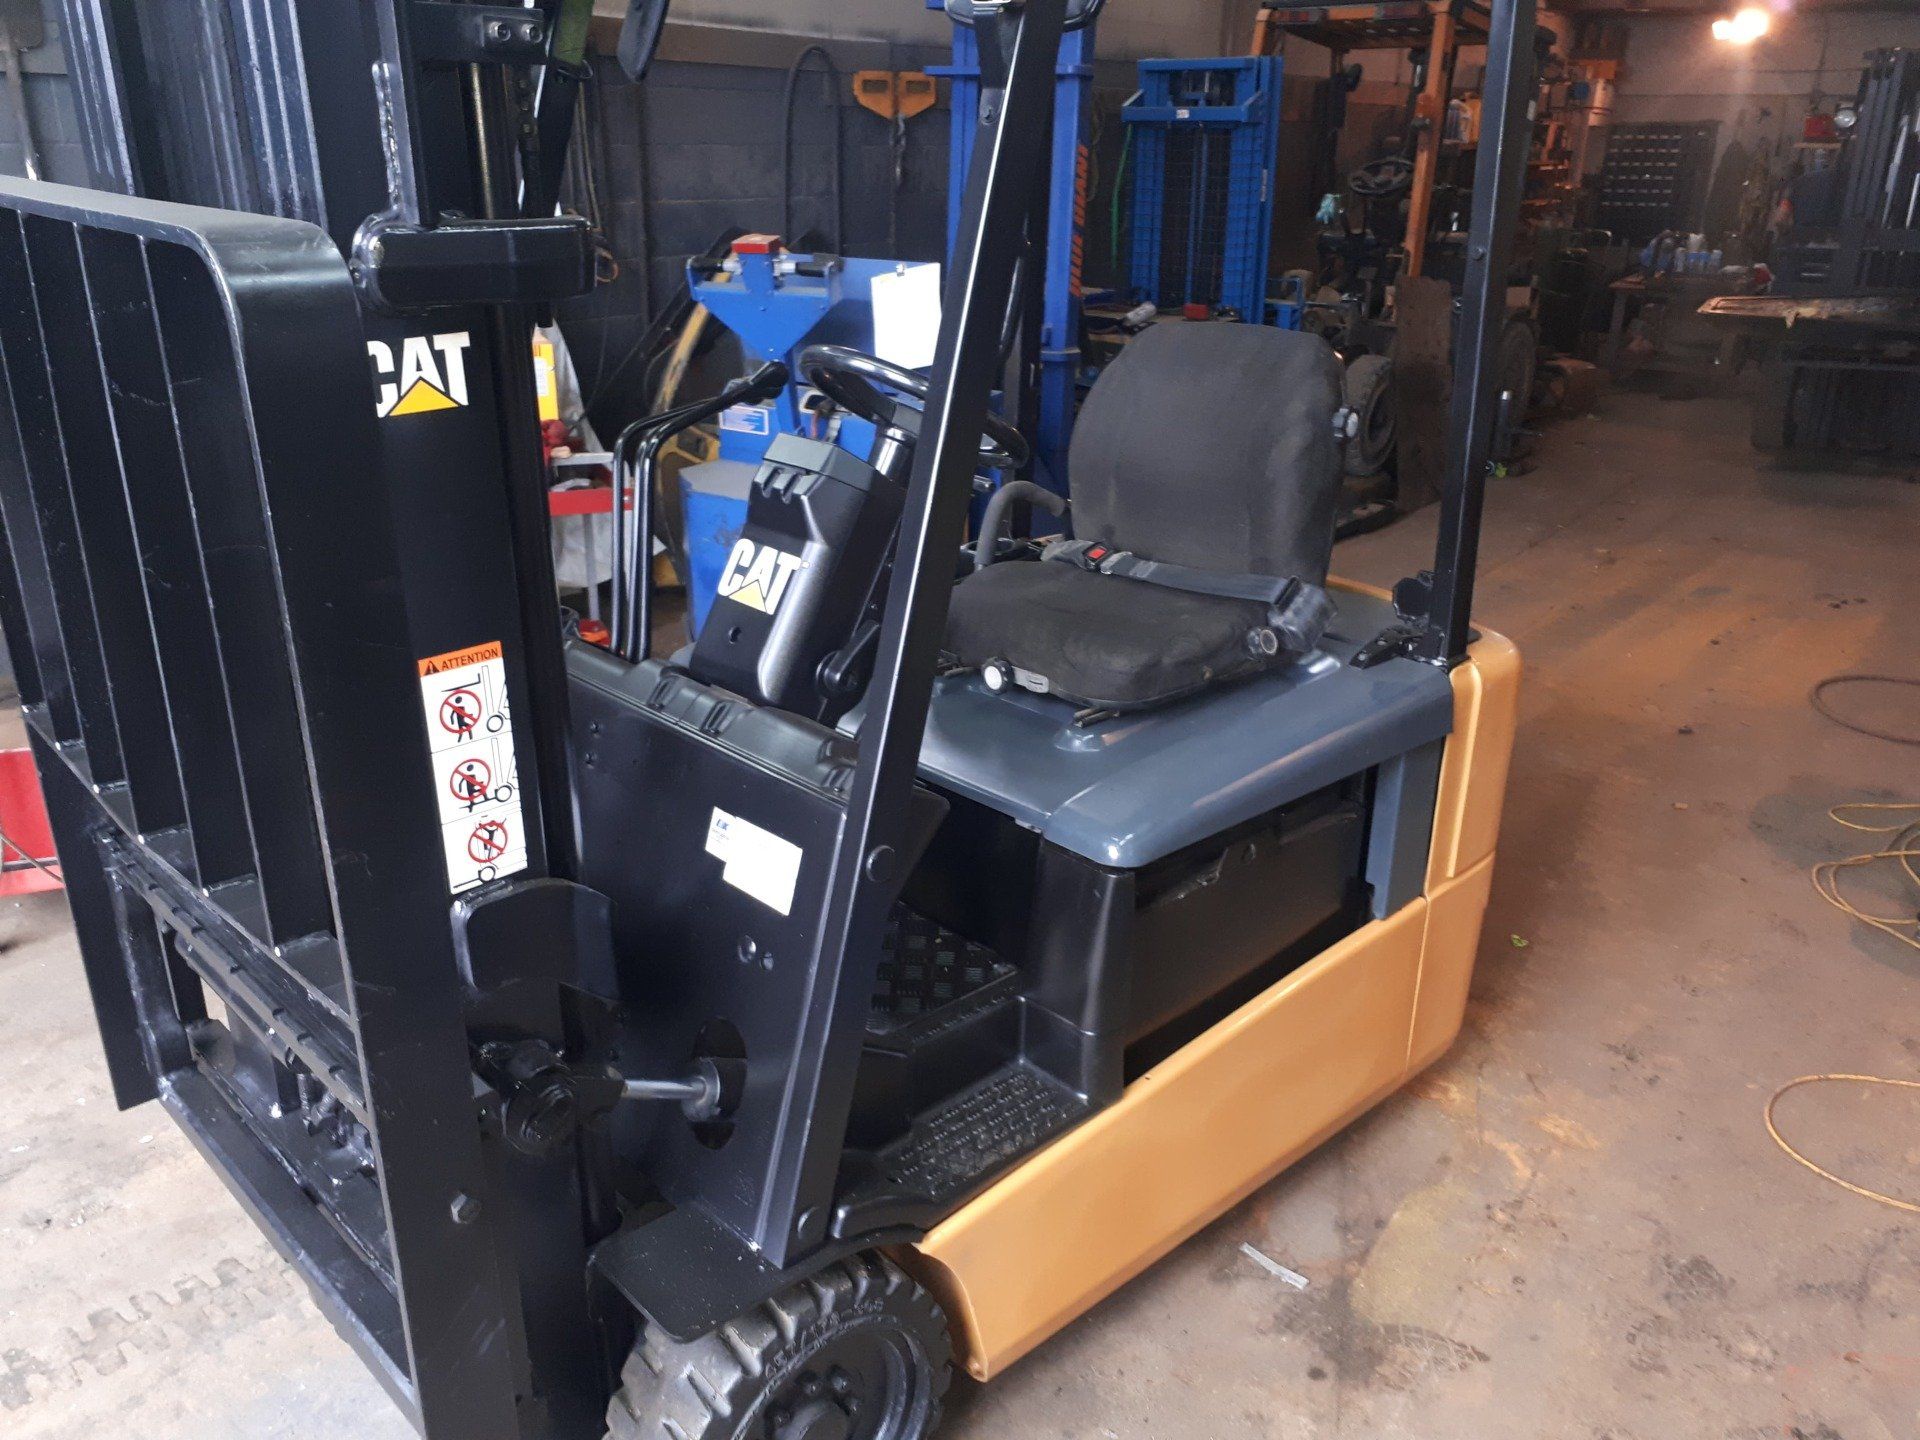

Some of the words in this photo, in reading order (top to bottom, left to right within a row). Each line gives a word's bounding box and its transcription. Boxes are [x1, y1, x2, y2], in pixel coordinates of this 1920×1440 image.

[367, 331, 470, 418] CAT
[717, 538, 802, 616] CAT
[441, 647, 499, 672] ATTENTION
